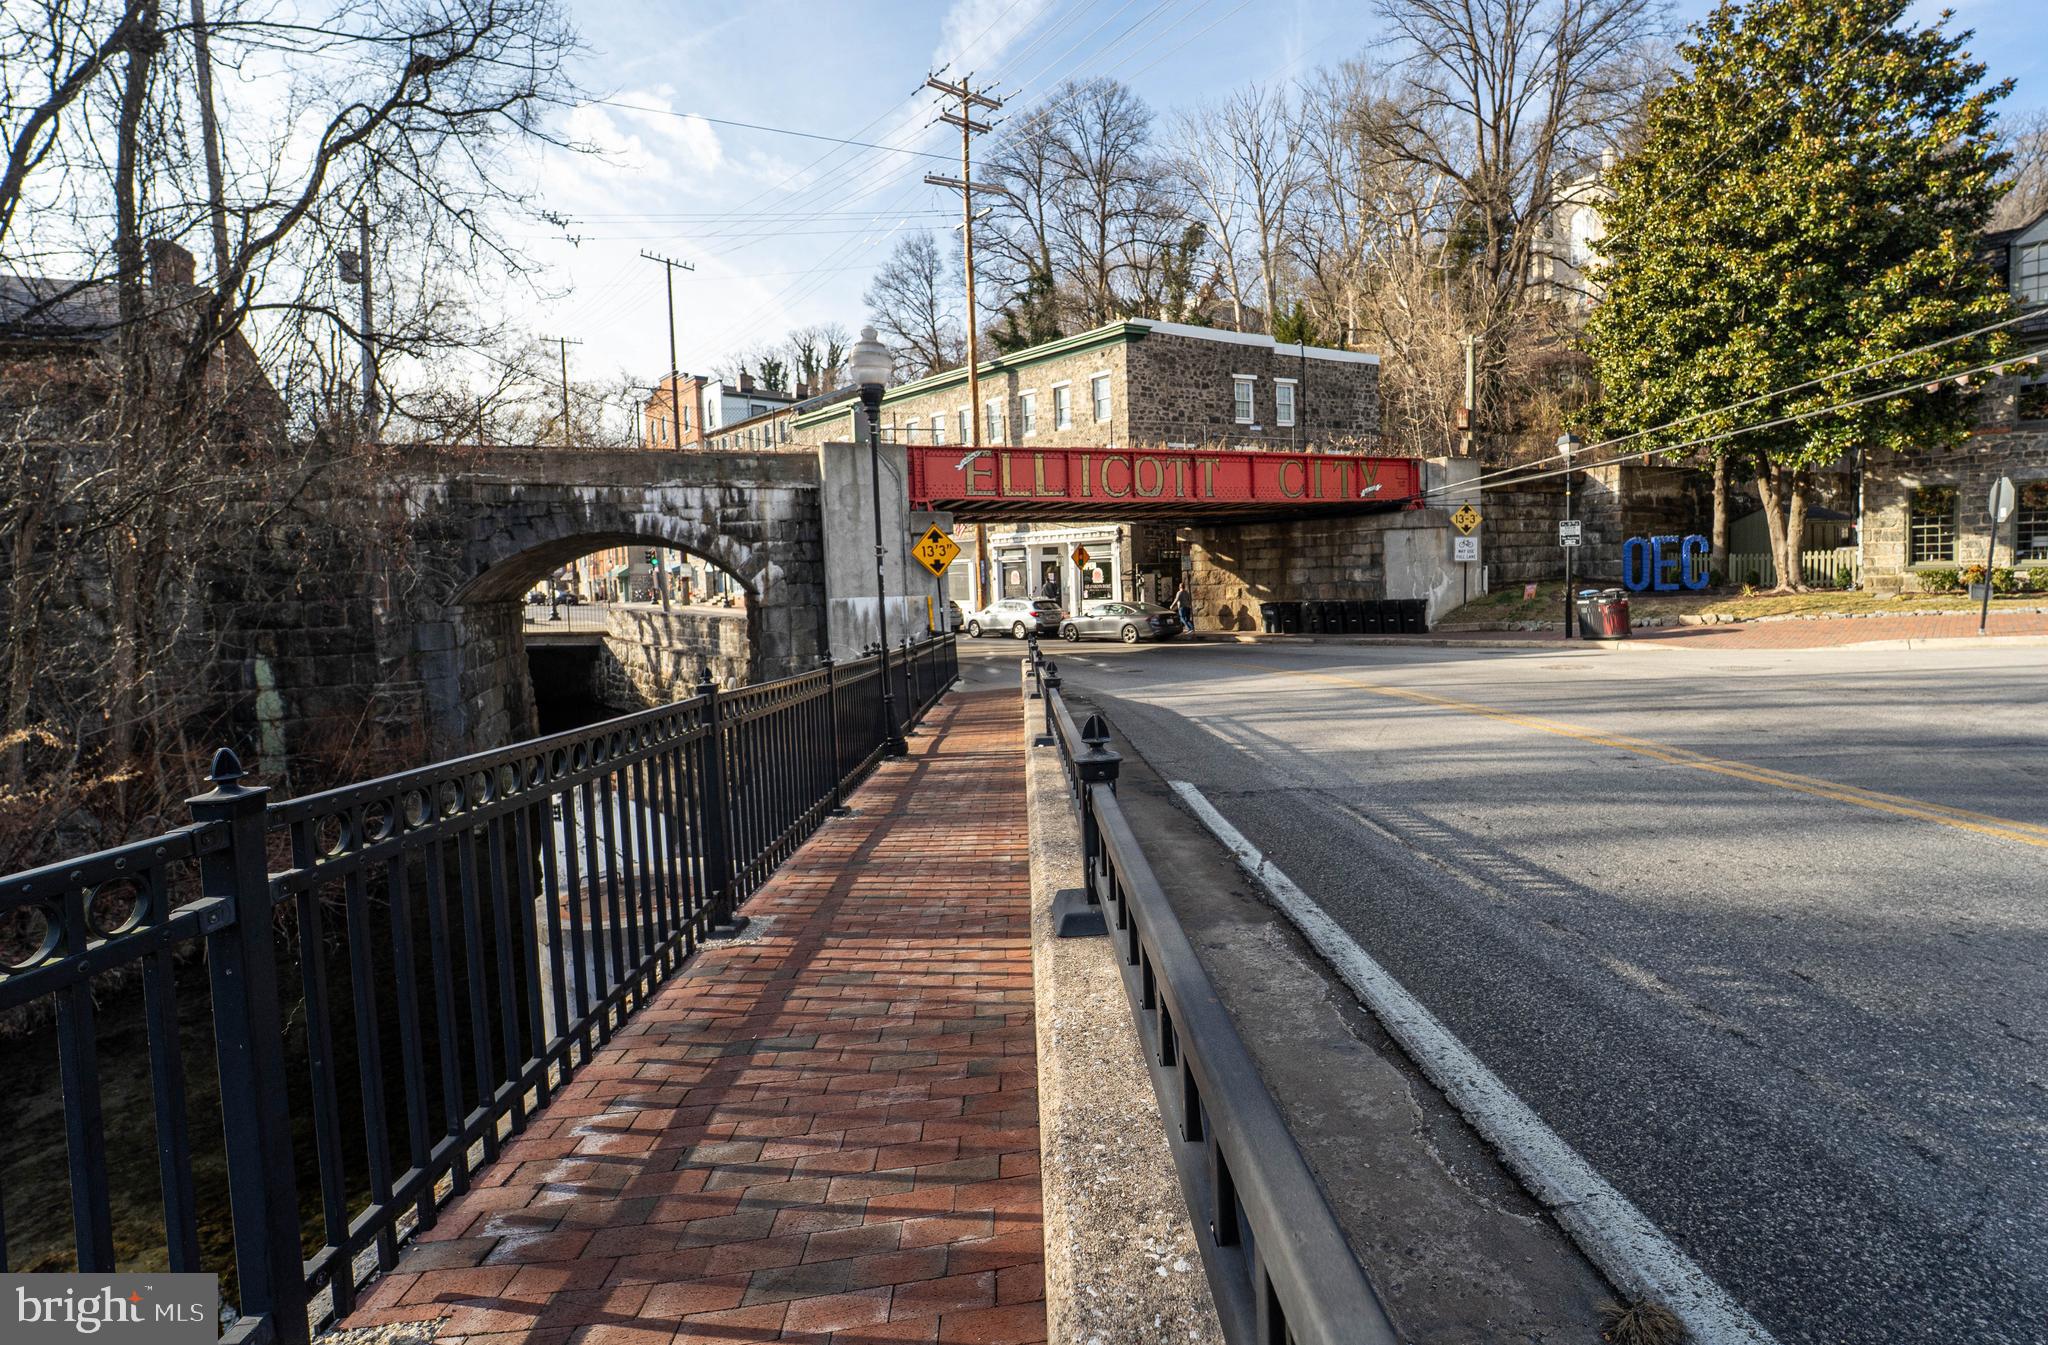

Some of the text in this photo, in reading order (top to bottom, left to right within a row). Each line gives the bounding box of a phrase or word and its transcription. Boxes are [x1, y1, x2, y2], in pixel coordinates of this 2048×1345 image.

[965, 450, 1380, 498] ELLICOTT CITY
[922, 544, 952, 557] 13'3"
[1622, 534, 1710, 592] OEC
